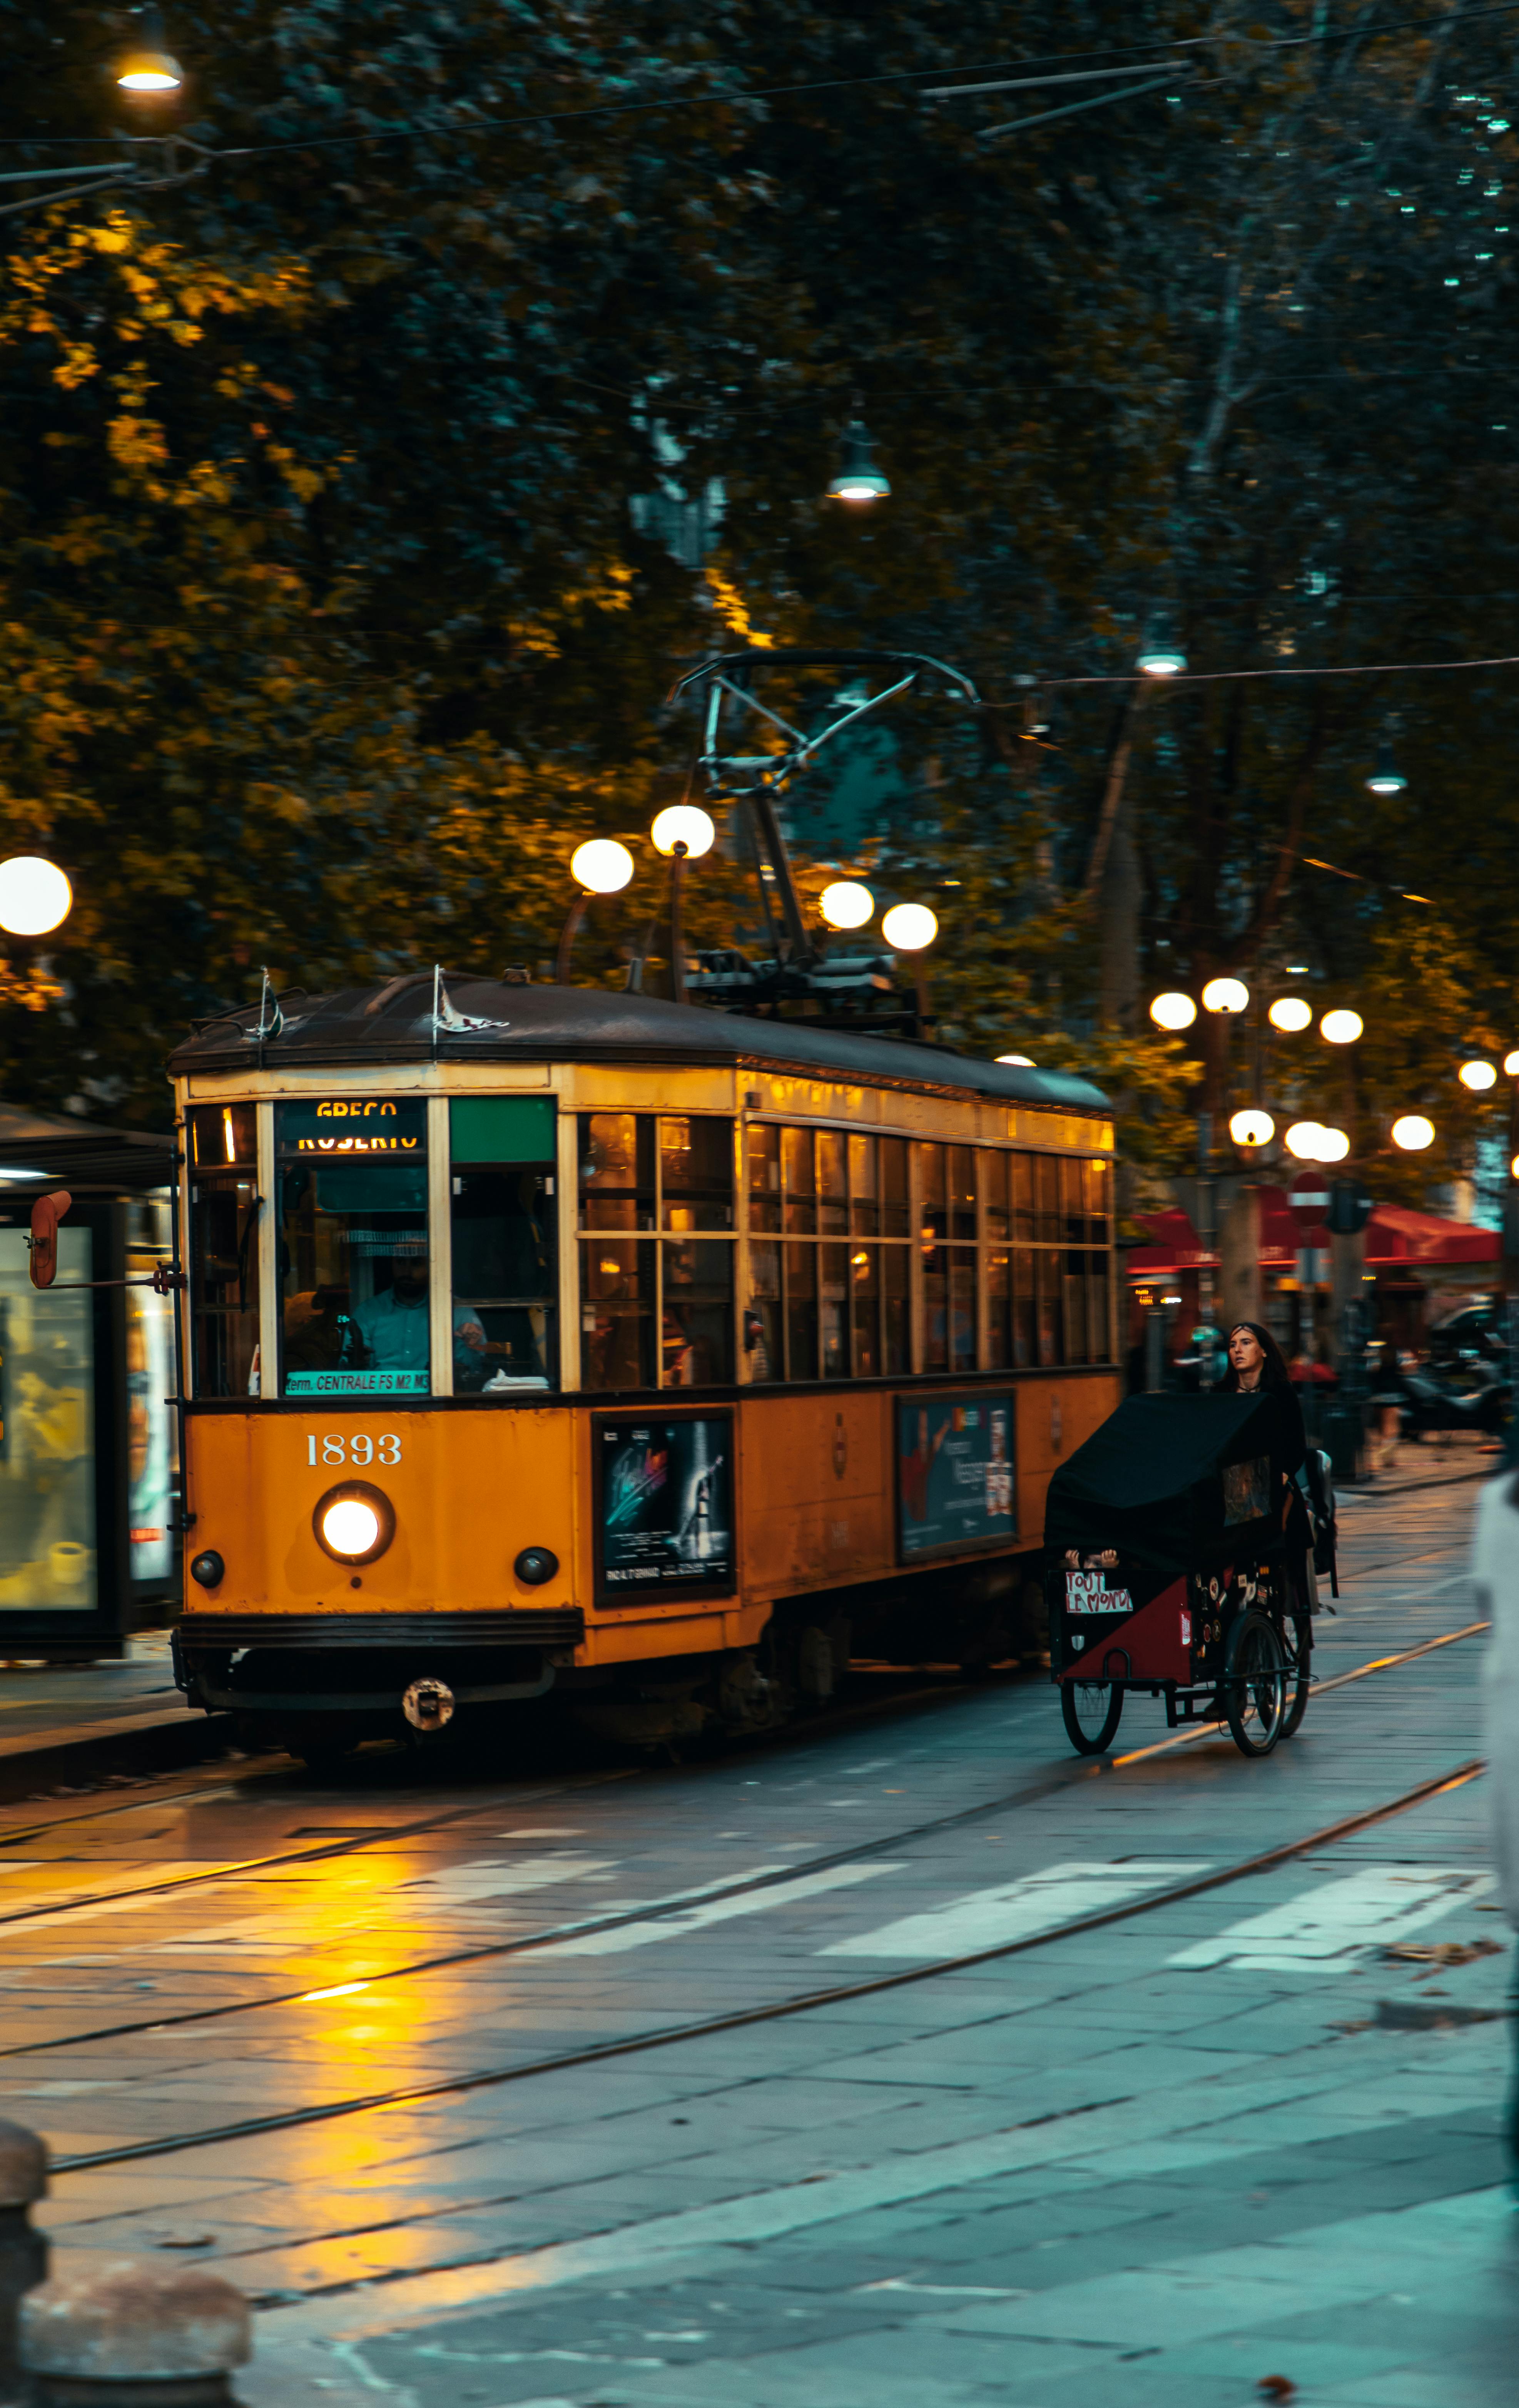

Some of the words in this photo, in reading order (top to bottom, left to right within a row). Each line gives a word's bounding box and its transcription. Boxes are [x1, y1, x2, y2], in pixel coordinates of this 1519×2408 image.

[316, 1375, 376, 1390] CENTRALE
[379, 1375, 393, 1389] FS
[395, 1375, 411, 1389] M2
[307, 1434, 402, 1466] 1893
[1067, 1572, 1104, 1593] TOUT
[1066, 1593, 1082, 1611] LE
